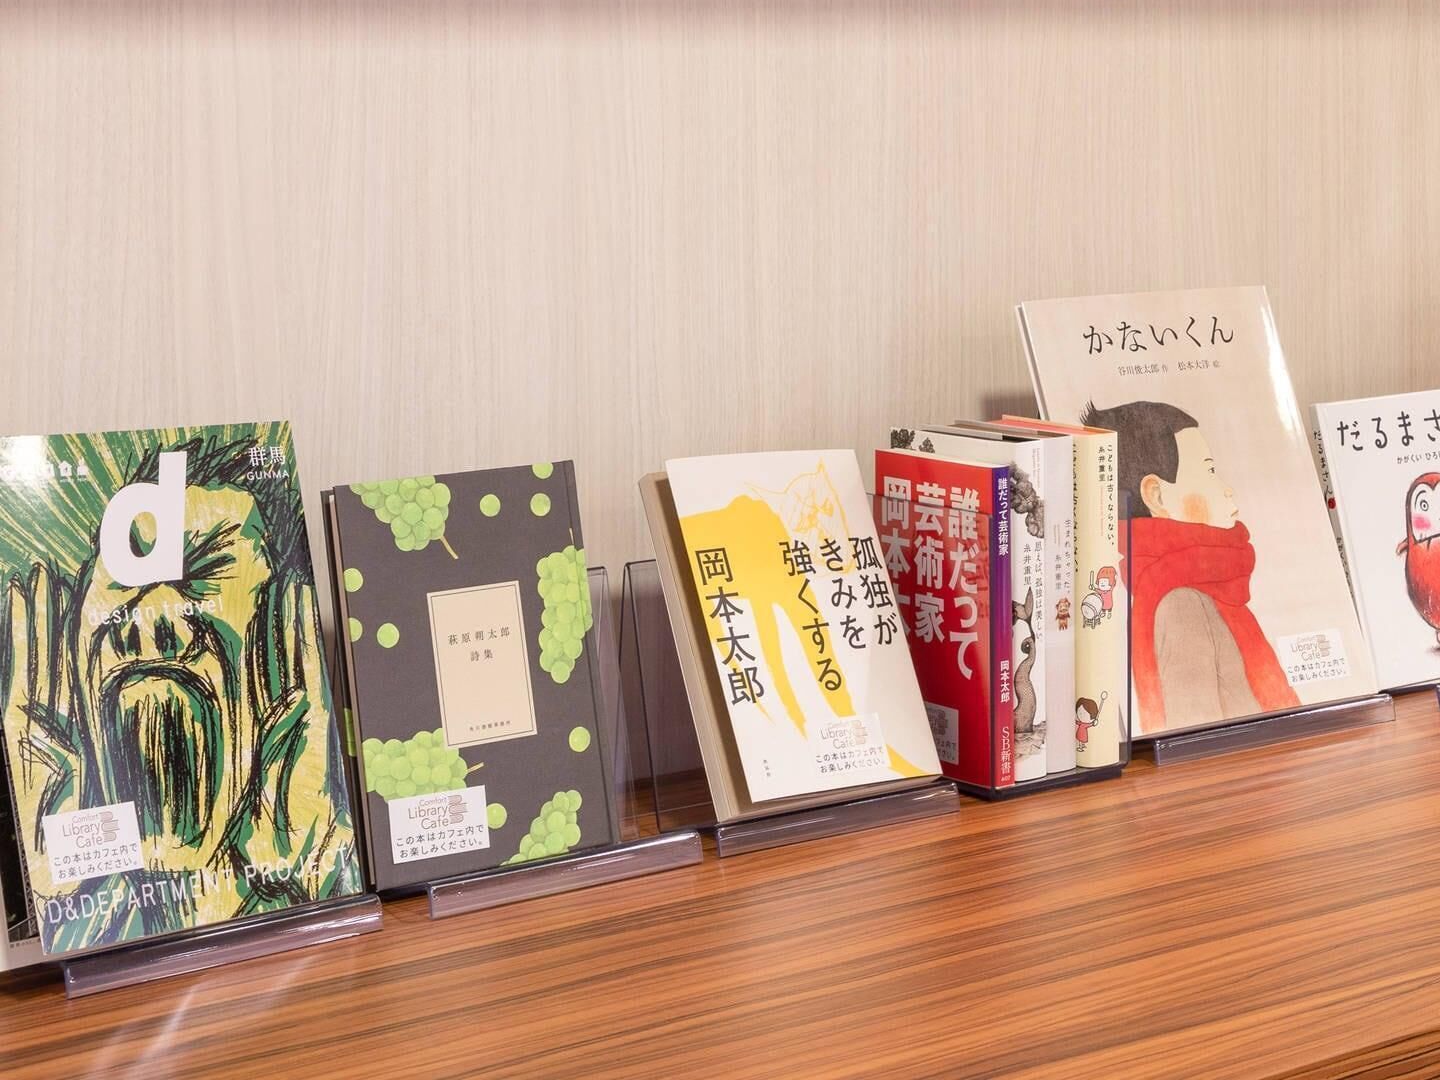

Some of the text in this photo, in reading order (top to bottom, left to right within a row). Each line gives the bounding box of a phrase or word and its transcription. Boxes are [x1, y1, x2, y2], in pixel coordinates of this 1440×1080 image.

[1082, 316, 1235, 355] かないくん
[249, 446, 286, 466] 群馬
[1313, 430, 1336, 509] だるまさん
[246, 471, 290, 481] GUNMA
[100, 451, 187, 587] d
[998, 477, 1009, 556] 誰だって芸術家
[914, 481, 946, 643] 芸術家
[821, 538, 867, 650] きみを
[849, 536, 898, 647] 孤独が
[948, 487, 980, 680] 誰だって
[88, 596, 224, 627] design travel
[779, 540, 843, 692] 強くする
[448, 627, 510, 645] 萩原朔太郎
[695, 548, 765, 706] 岡本太郎
[471, 649, 493, 662] 詩集
[1000, 661, 1010, 704] 岡本太郎
[820, 727, 852, 740] Library
[816, 746, 883, 763] この本はカフェ内で
[1001, 726, 1011, 775] SB新書
[408, 805, 448, 819] Library
[421, 815, 449, 830] Cafe
[62, 822, 100, 837] Library
[76, 833, 103, 848] Cafe
[396, 824, 484, 847] この本はカフェ内で
[54, 843, 137, 867] この本はカフェ内で
[400, 838, 482, 858] お楽しみください。
[59, 858, 137, 879] お楽しみください。
[47, 847, 349, 923] D&DEPARTMENT PROJECT
